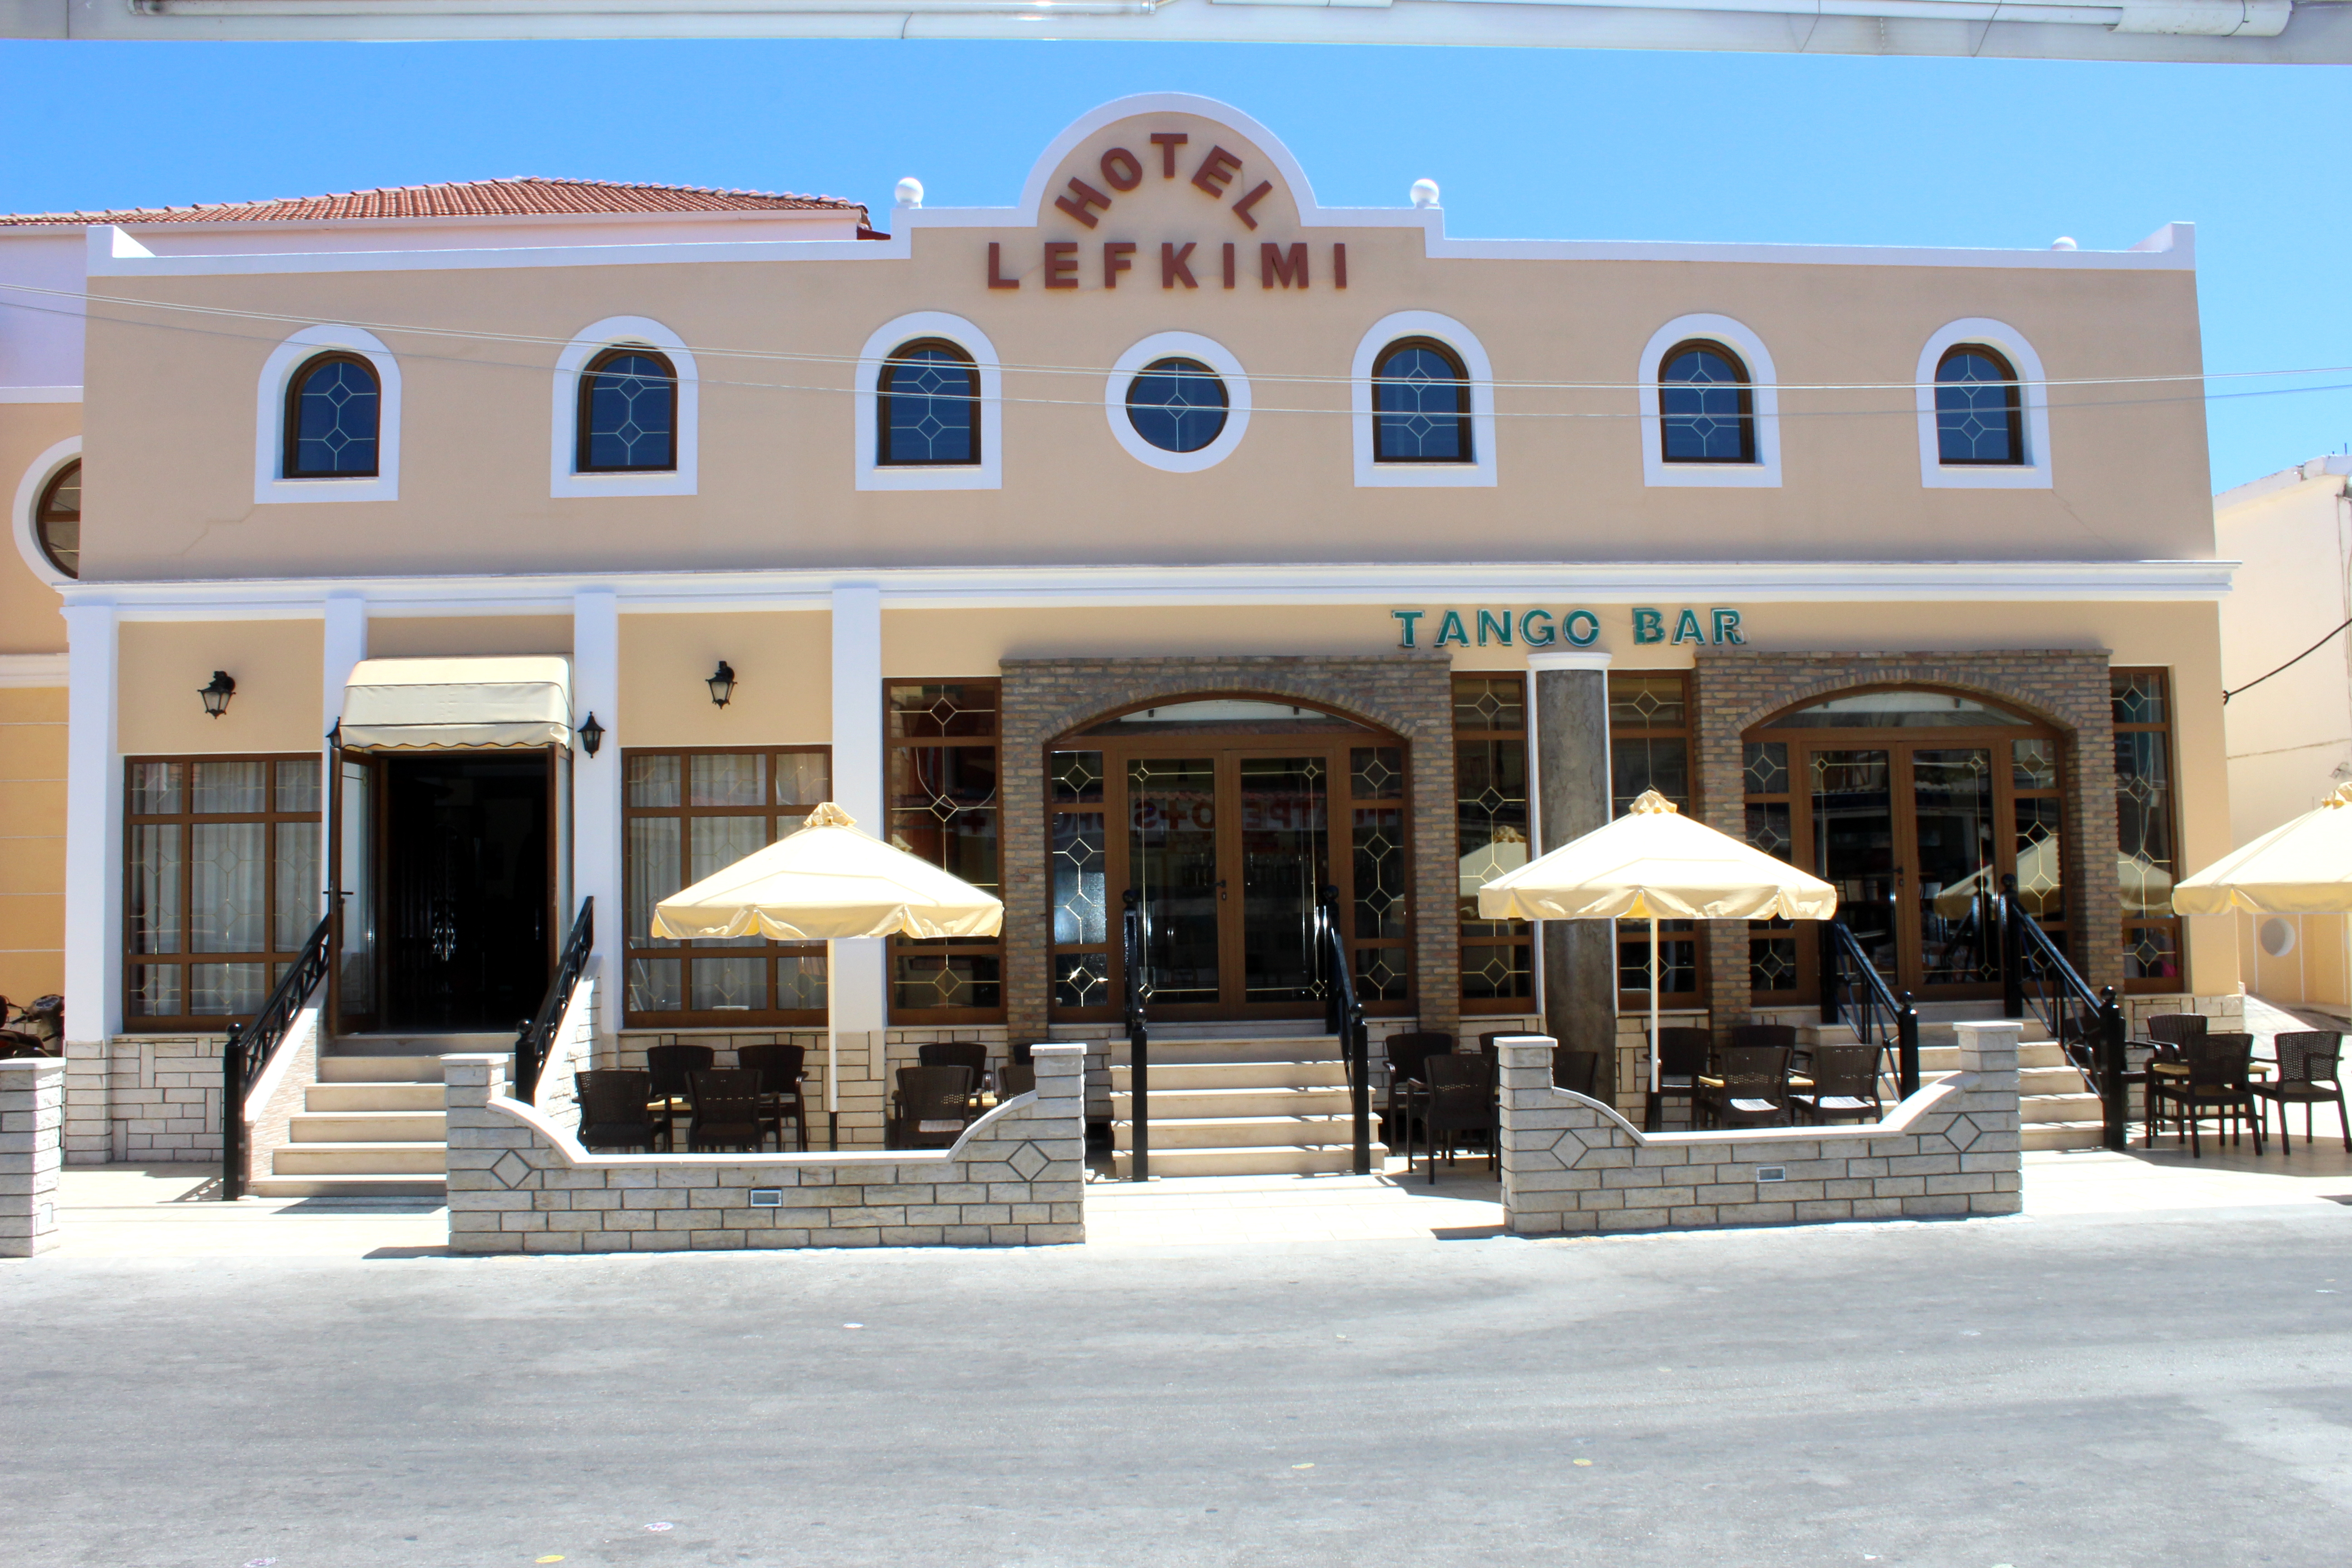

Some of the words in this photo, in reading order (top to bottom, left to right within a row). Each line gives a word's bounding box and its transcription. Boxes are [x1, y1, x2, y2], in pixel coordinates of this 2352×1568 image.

[1054, 133, 1273, 231] HOTEL
[987, 242, 1347, 289] LEFKIMI
[1391, 608, 1600, 647] TANGO
[1632, 608, 1745, 646] BAR
